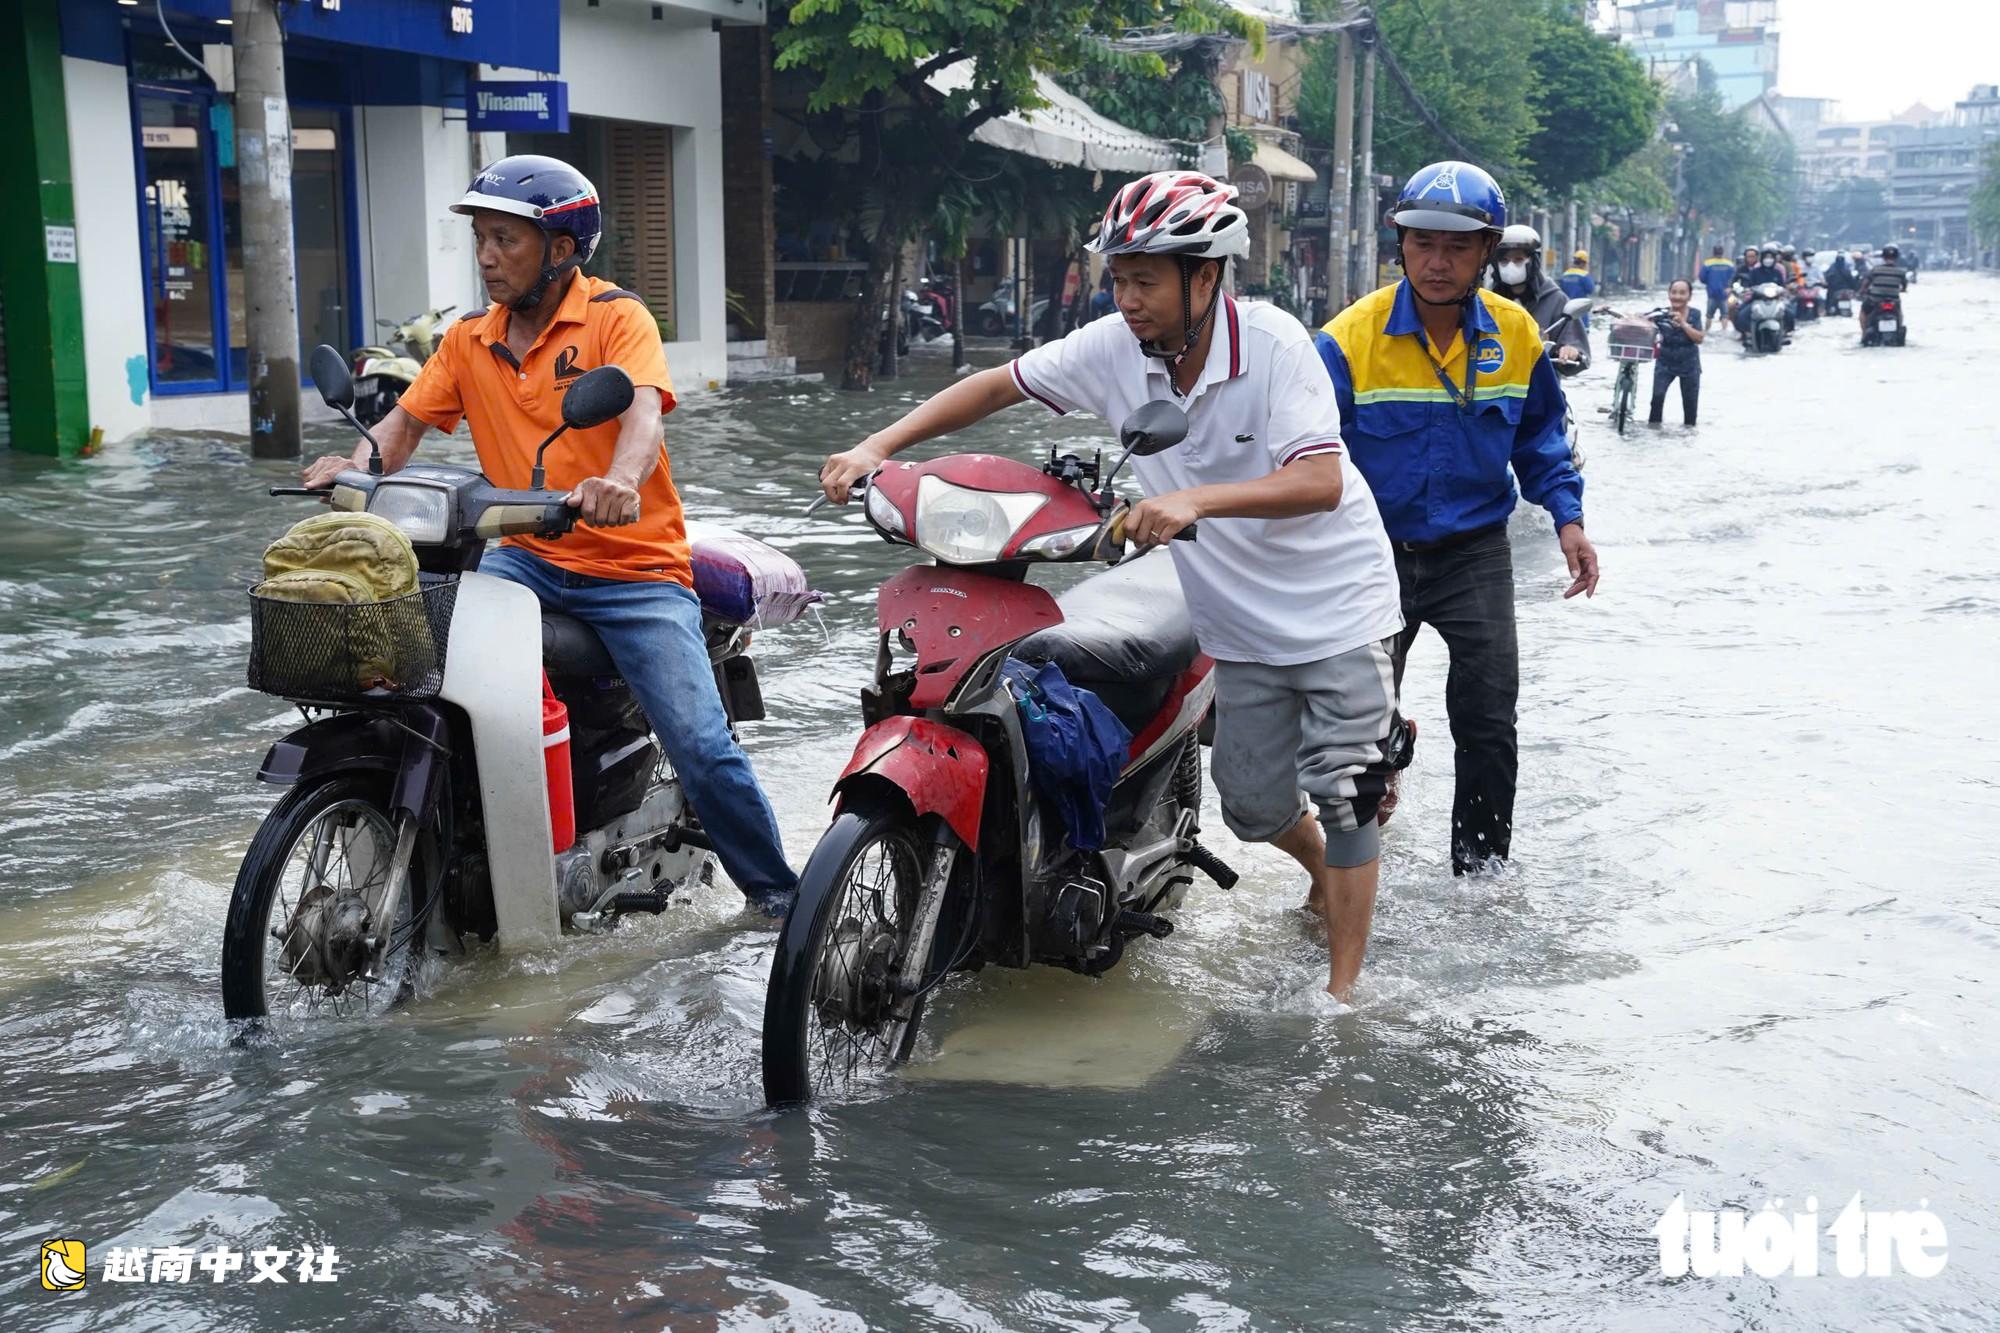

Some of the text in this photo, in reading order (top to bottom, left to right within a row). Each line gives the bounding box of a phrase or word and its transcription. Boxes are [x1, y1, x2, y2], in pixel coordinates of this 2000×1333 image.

[451, 6, 473, 33] 1976
[477, 91, 549, 112] Vinamilk
[930, 587, 967, 598] HONDA
